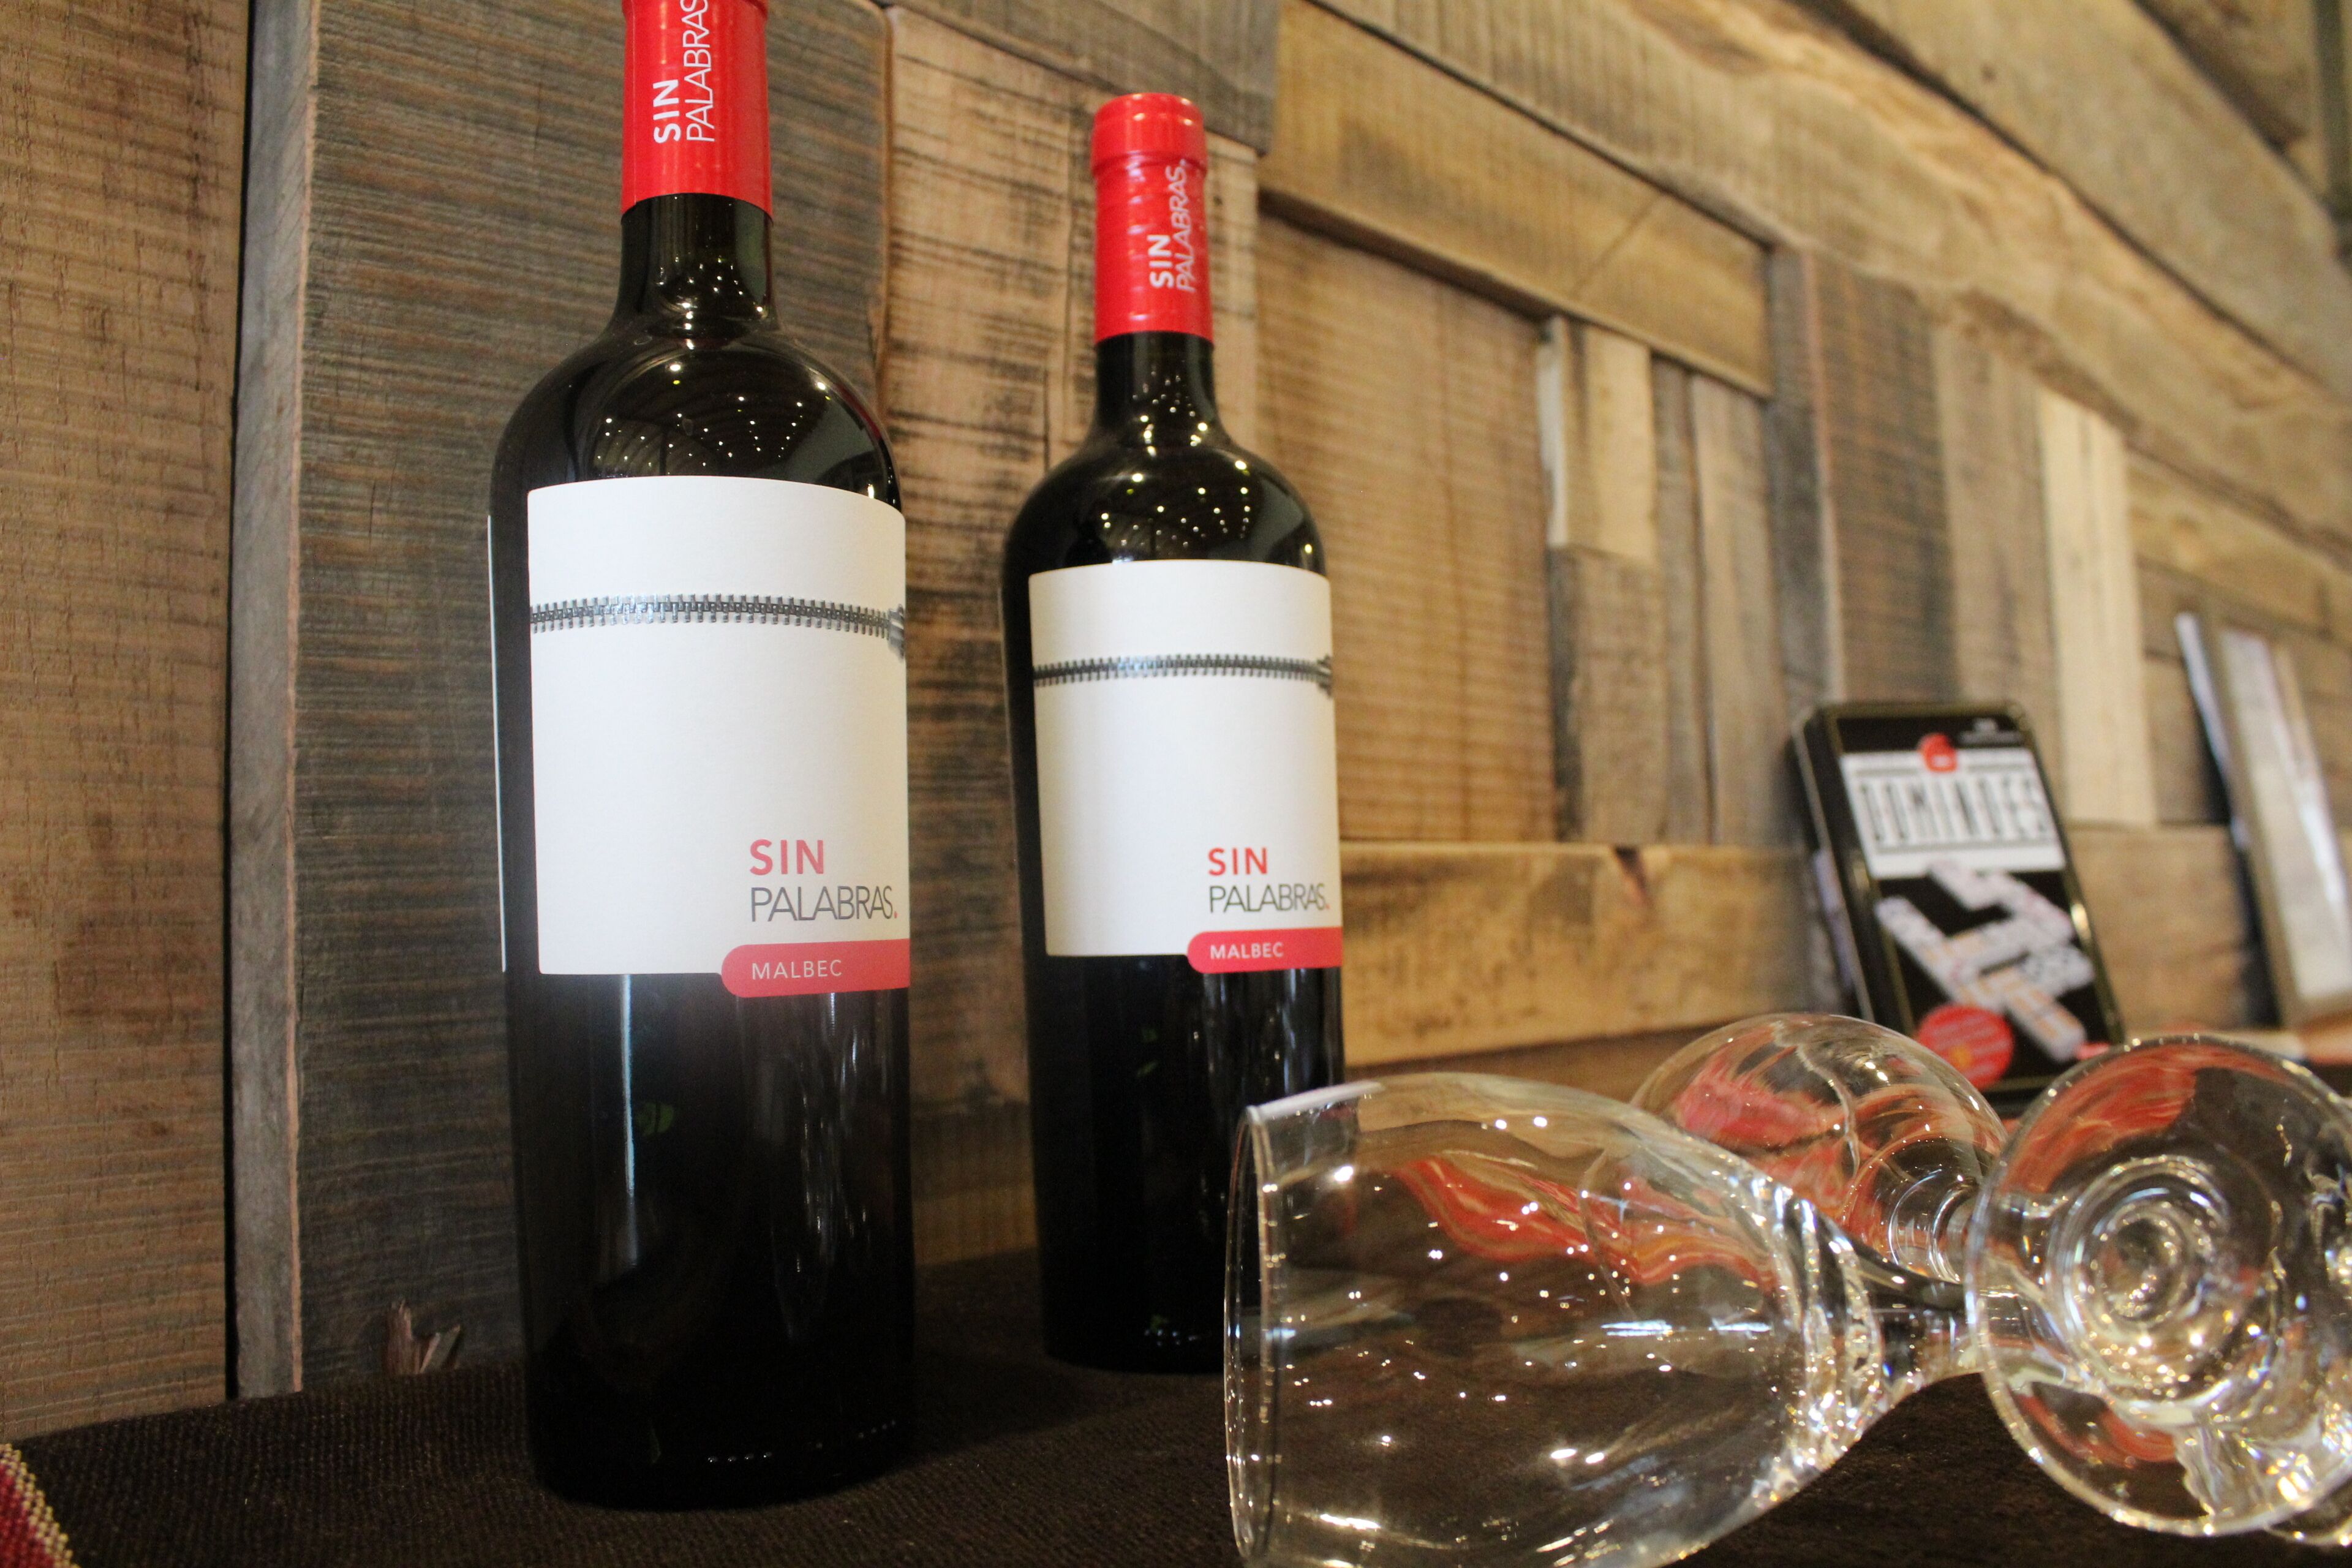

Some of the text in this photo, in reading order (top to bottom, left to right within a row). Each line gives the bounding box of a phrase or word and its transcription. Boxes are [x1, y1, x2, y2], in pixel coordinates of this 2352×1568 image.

[652, 79, 681, 144] SIN
[1147, 234, 1174, 288] SIN
[749, 839, 824, 876] SIN
[1207, 846, 1268, 876] SIN
[750, 885, 899, 922] PALABRAS.
[1208, 941, 1284, 960] MALBEC
[751, 959, 843, 980] MALBEC
